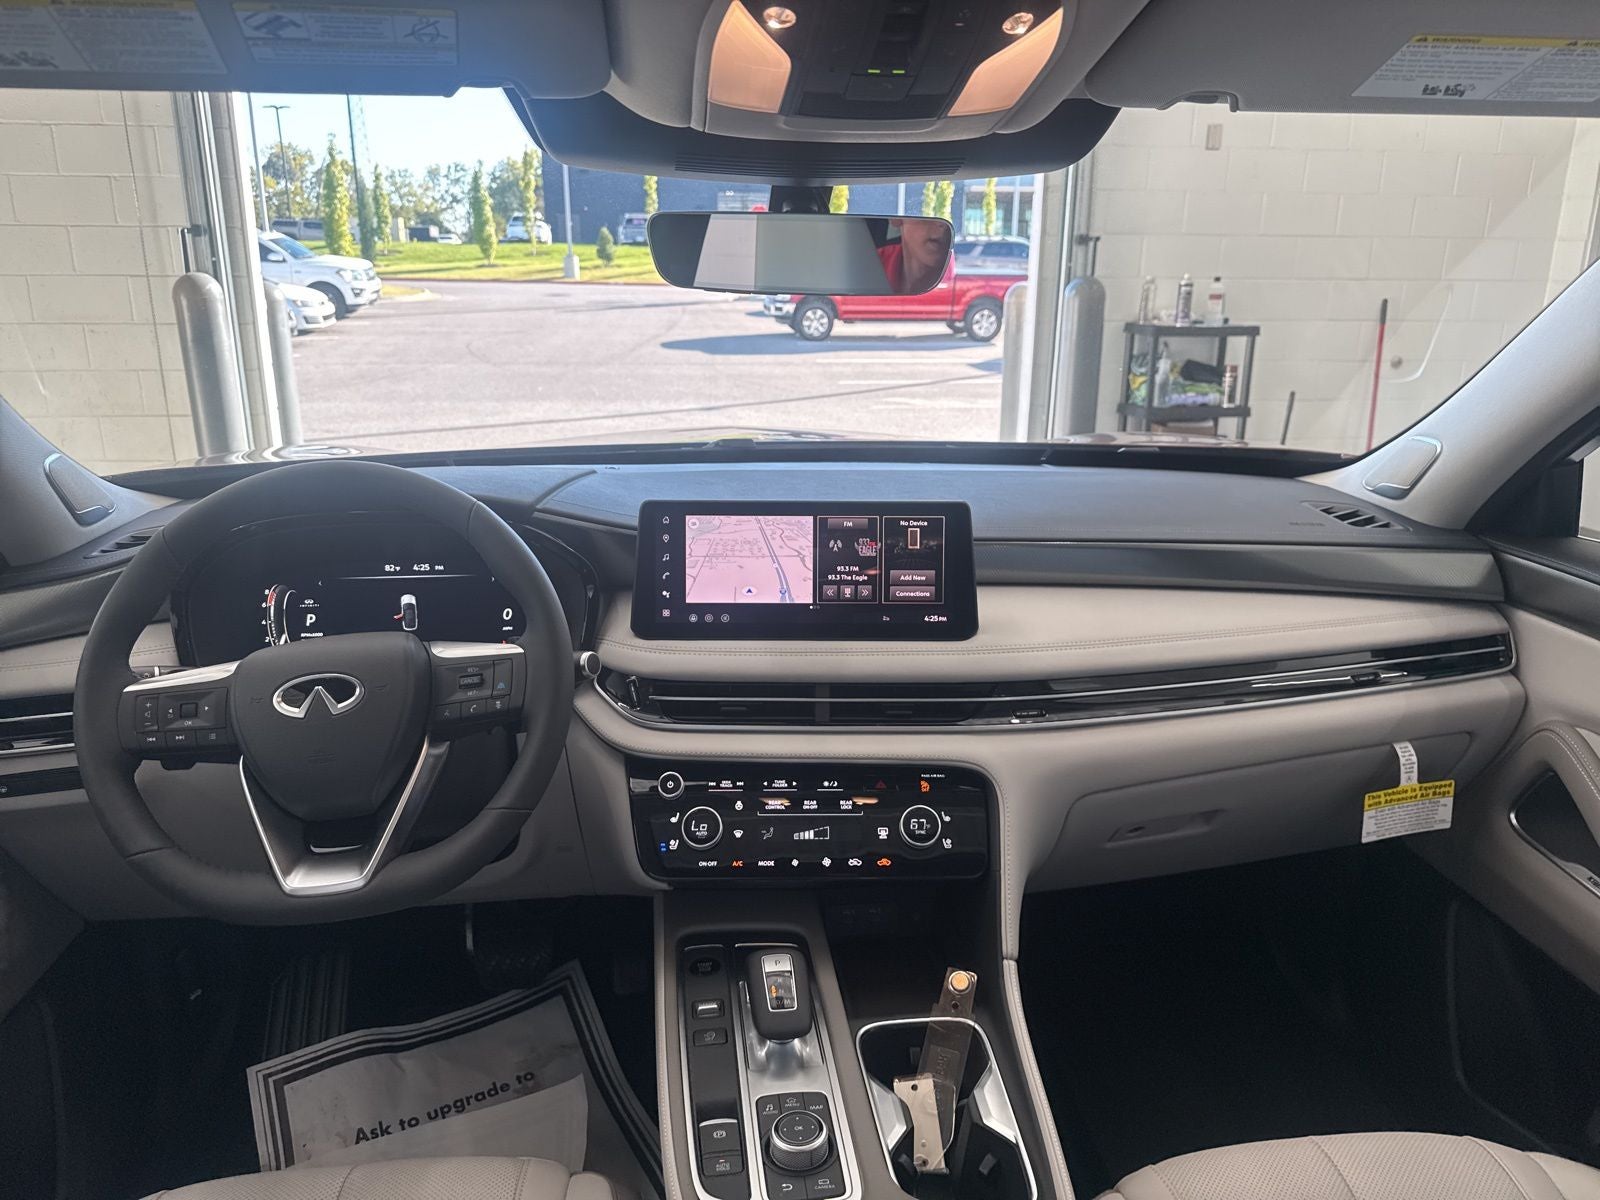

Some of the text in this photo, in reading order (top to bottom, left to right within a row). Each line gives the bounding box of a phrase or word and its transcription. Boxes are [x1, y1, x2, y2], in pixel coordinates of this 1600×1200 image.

[306, 614, 316, 626] P
[502, 608, 512, 620] 0
[1384, 789, 1408, 798] Vehicle
[1419, 782, 1452, 792] Equipped
[1384, 794, 1418, 804] Advanced
[1432, 789, 1450, 797] Bags
[354, 1071, 535, 1145] Ask to upgrade to
